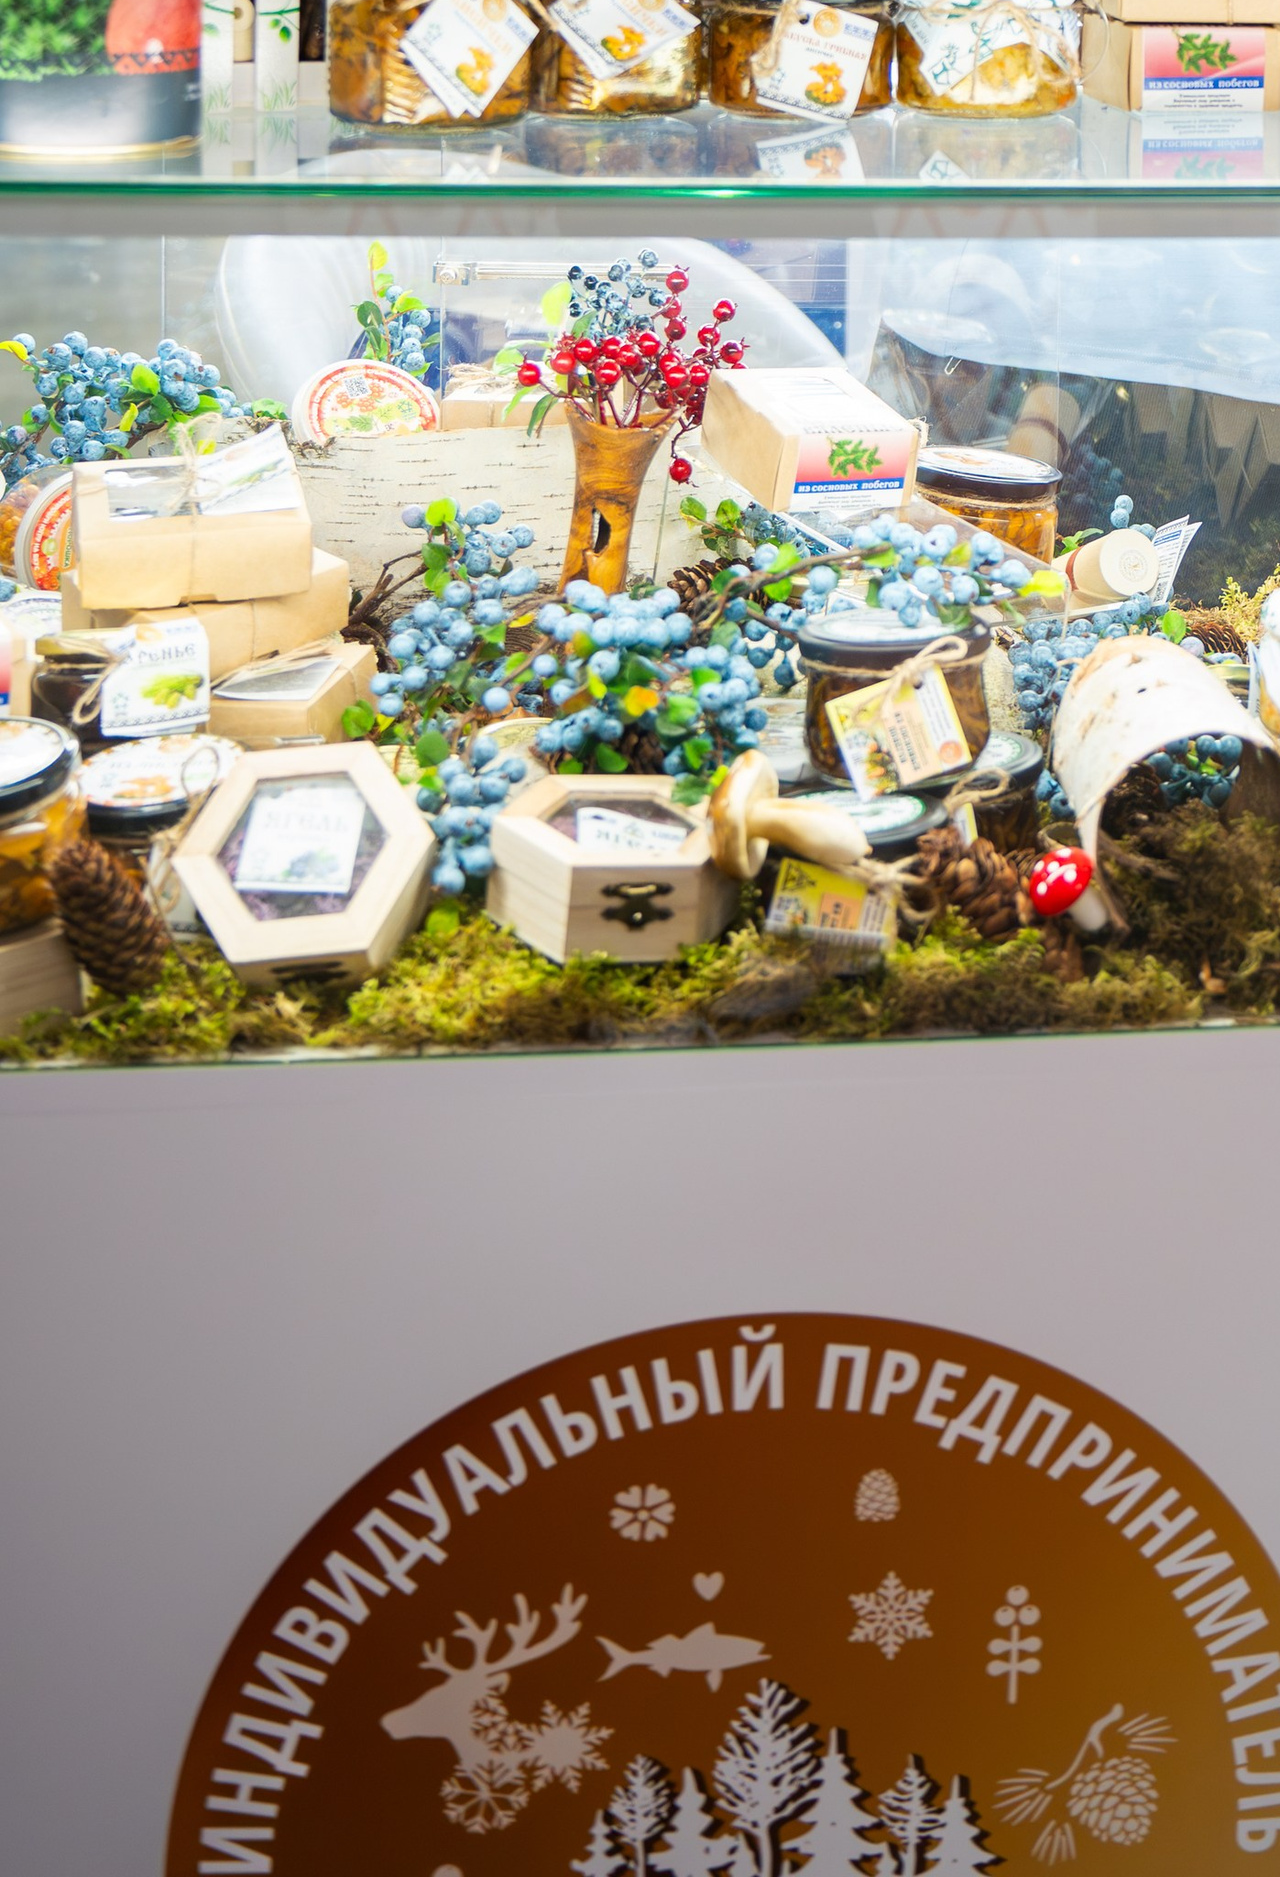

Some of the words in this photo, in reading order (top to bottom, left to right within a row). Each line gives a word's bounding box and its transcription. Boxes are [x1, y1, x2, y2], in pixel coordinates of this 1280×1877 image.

[1163, 79, 1215, 89] сосновых
[1218, 77, 1260, 89] побегов
[811, 482, 858, 493] сосновых
[861, 479, 900, 490] побегов
[198, 1323, 786, 1875] ИНДИВИДУАЛЬНЫЙ
